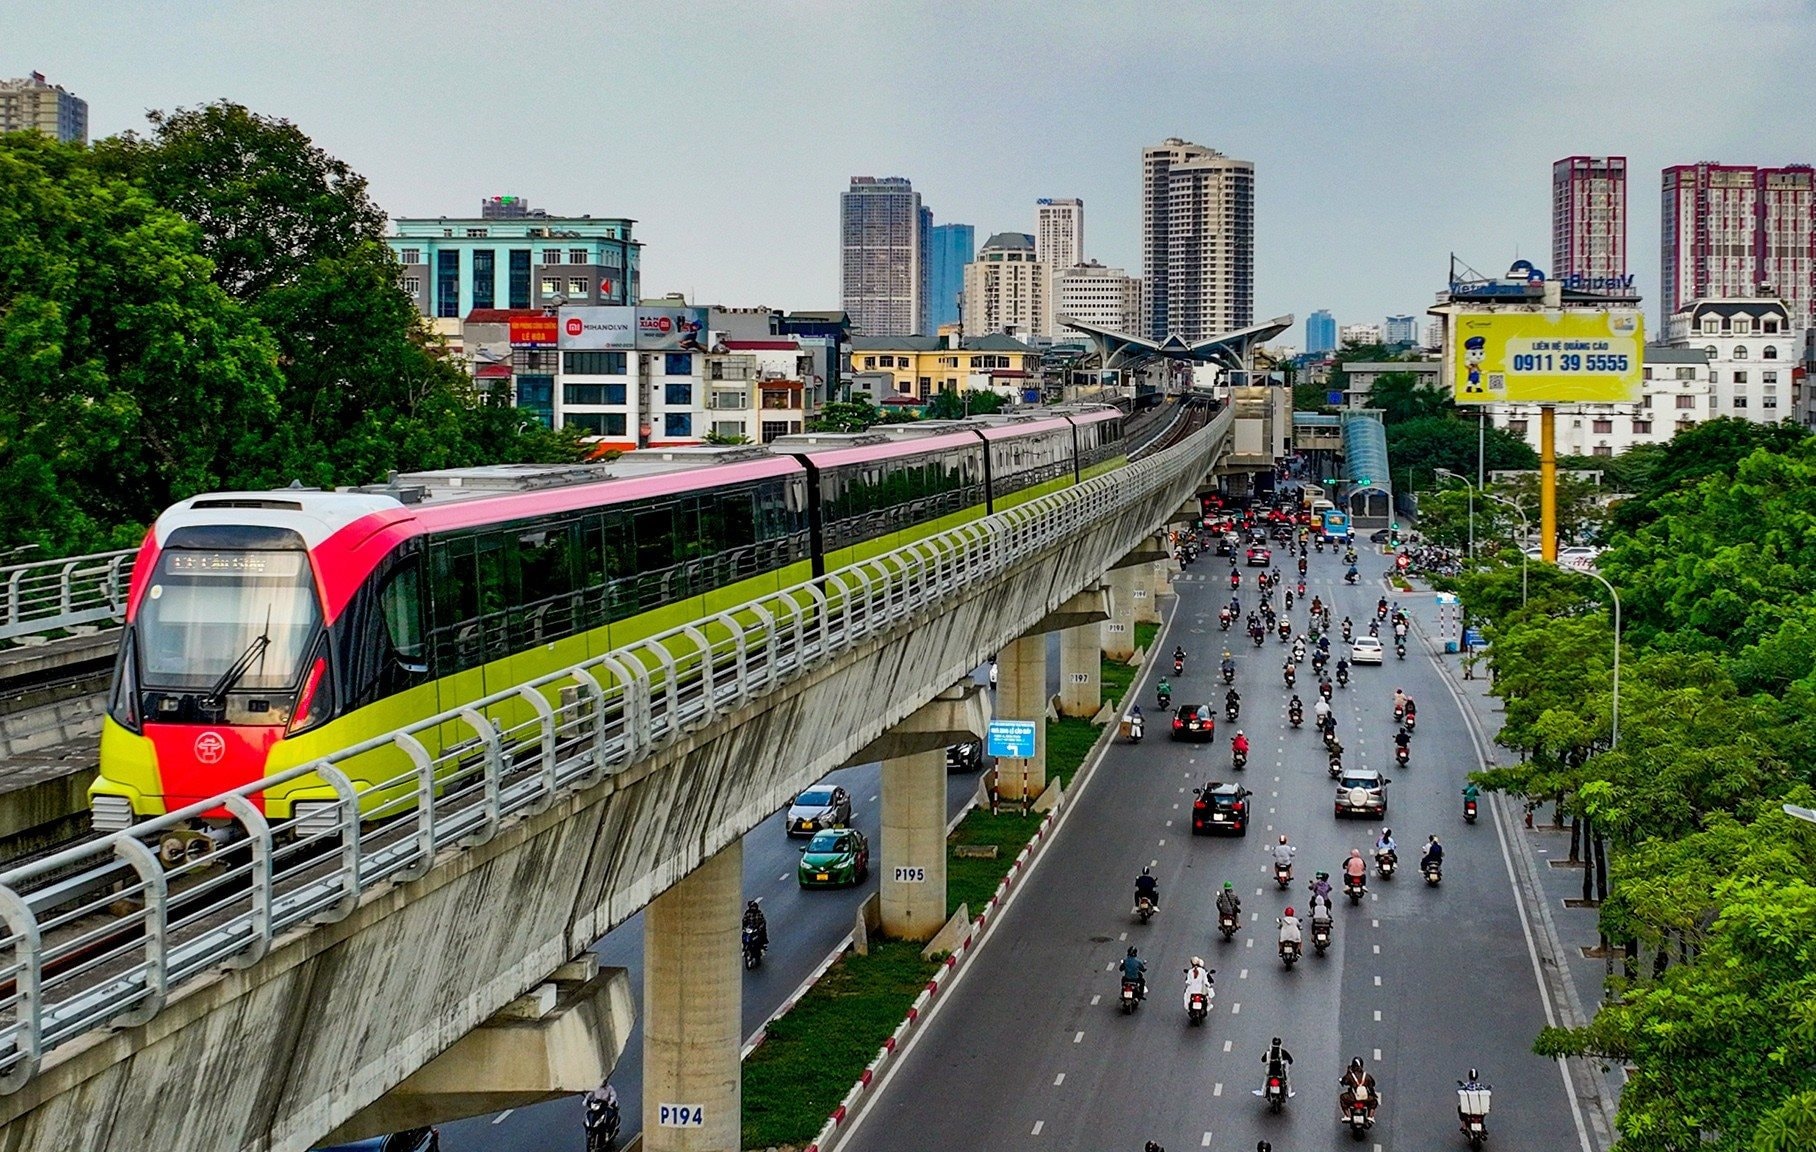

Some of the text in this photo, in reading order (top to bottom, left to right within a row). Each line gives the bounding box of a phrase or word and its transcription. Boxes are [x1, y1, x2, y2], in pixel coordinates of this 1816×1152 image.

[1532, 340, 1609, 352] LIÊN HỆ QUẢNG CÁO
[1513, 354, 1628, 372] 0911 39 5555
[895, 868, 924, 881] P195
[661, 1106, 703, 1125] P194
